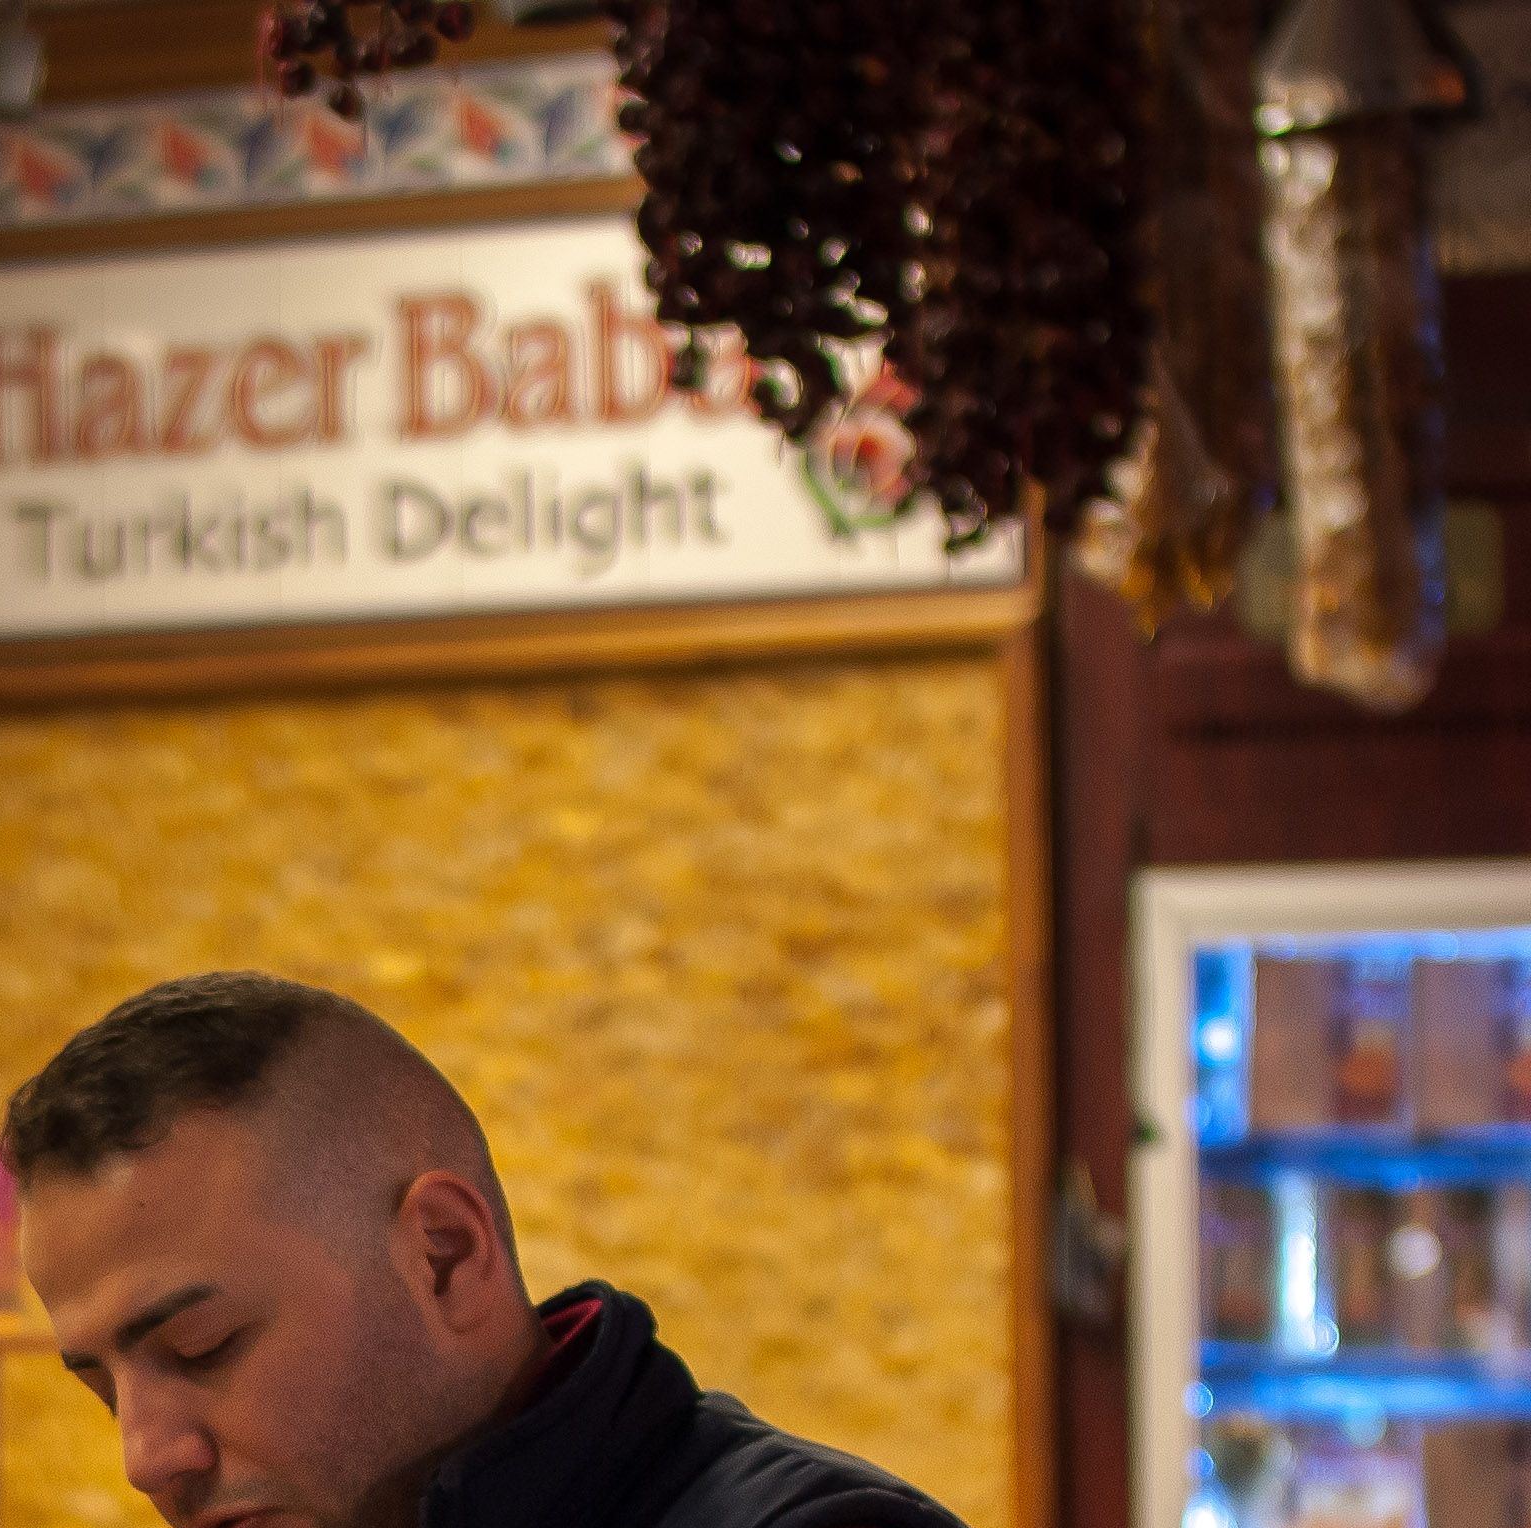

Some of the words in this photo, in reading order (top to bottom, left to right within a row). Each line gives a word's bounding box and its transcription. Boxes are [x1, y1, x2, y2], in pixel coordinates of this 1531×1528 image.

[395, 276, 763, 446] Baba
[9, 482, 354, 588] Turkish
[377, 460, 731, 578] Delight
